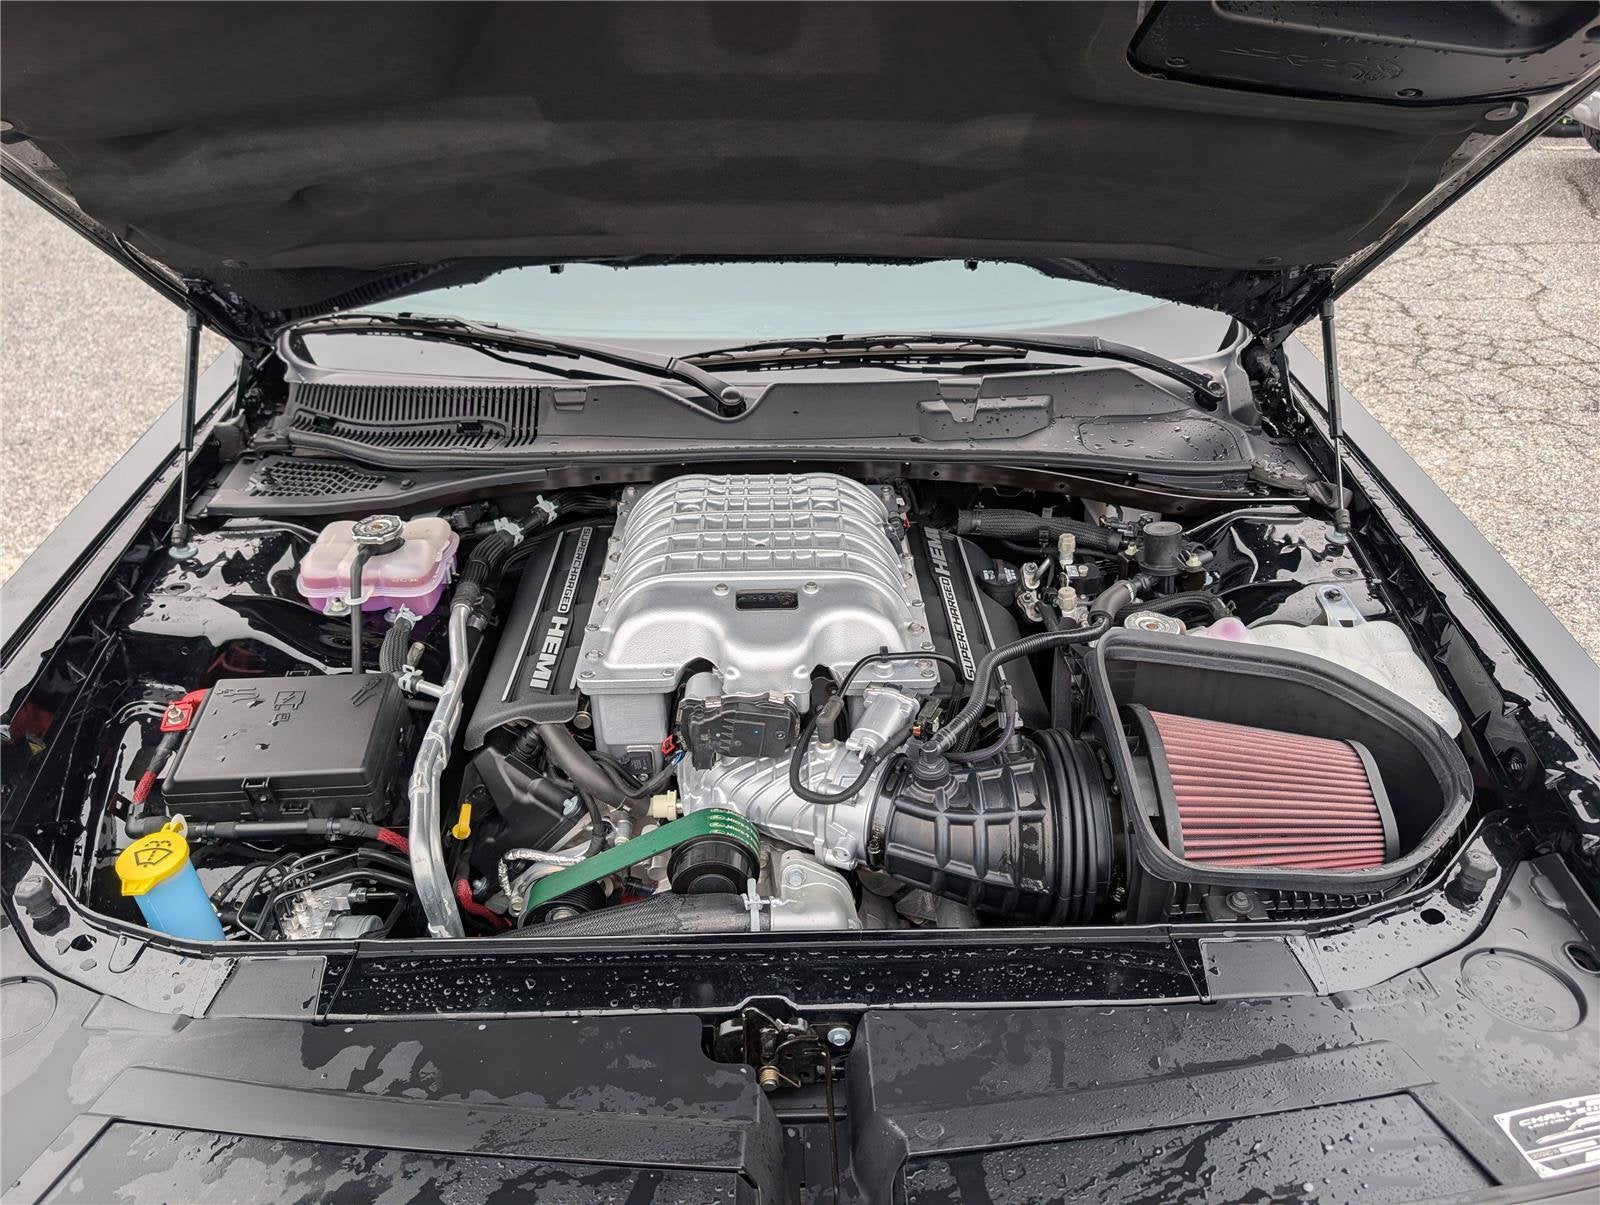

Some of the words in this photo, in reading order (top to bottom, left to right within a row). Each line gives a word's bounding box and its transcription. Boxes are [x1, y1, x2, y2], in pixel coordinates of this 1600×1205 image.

[558, 527, 593, 613] SUPERCHARGED
[923, 526, 950, 576] HEMI
[529, 615, 568, 689] HEMI
[939, 577, 977, 681] SUPERCHARGED
